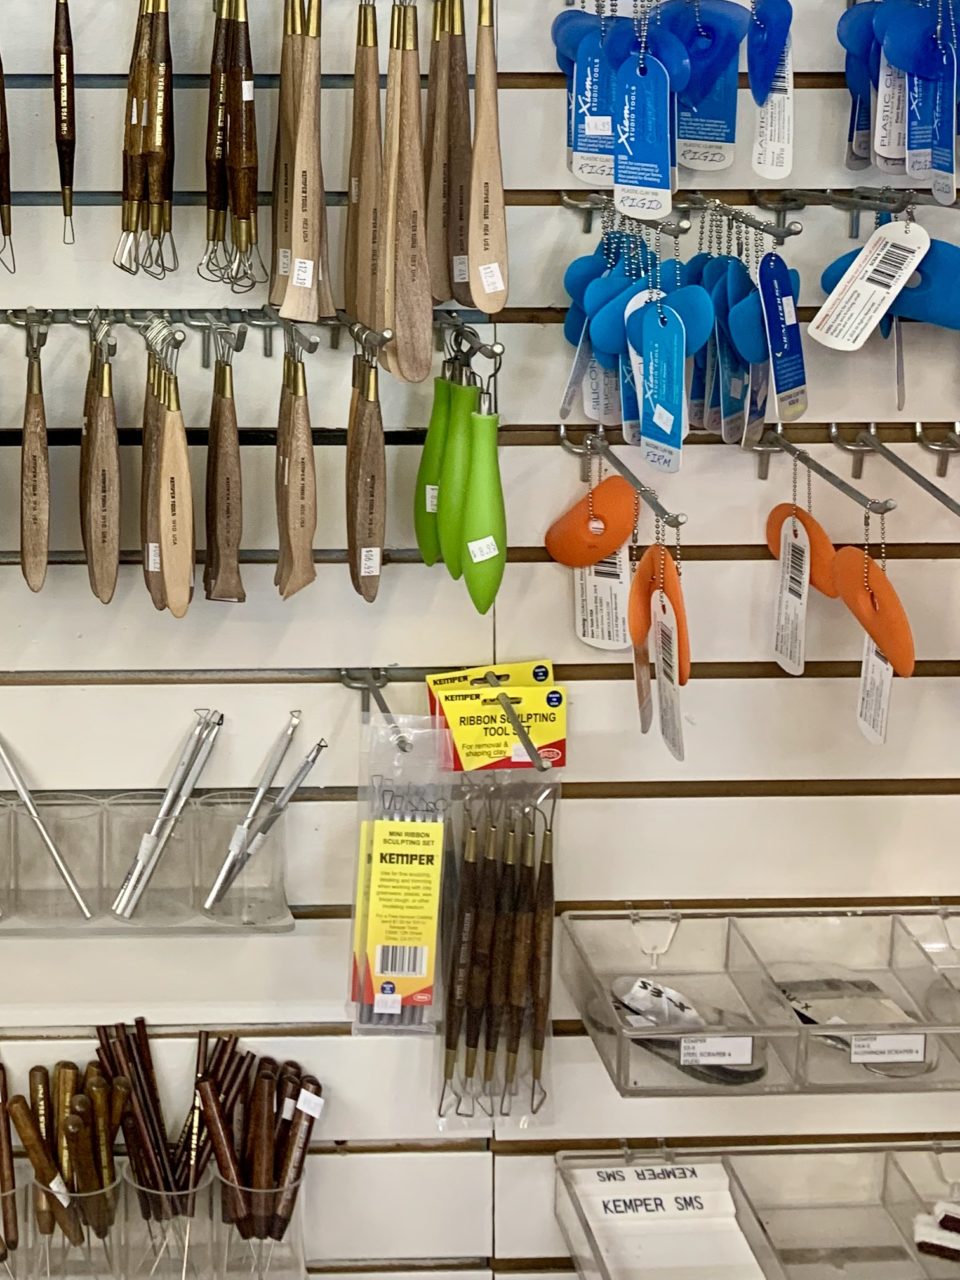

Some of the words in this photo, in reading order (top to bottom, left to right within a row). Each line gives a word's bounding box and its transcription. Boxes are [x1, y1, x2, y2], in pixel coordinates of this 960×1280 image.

[880, 94, 891, 147] PLASTIC
[681, 150, 726, 162] RIGID
[619, 197, 663, 210] RIGID
[646, 451, 672, 466] FIRM
[433, 675, 469, 686] KEMPER
[444, 693, 481, 702] KEMPER
[459, 715, 497, 726] RIBBON
[483, 727, 510, 737] TOOL
[513, 725, 532, 736] ST
[474, 742, 502, 750] removal
[465, 750, 491, 759] shaping
[493, 749, 507, 758] clay
[382, 838, 421, 846] SCULPTING
[379, 852, 436, 866] KEMPER
[597, 1169, 626, 1183] SMS
[635, 1167, 698, 1182] KEMPER
[602, 1197, 666, 1214] KEMPER
[674, 1196, 705, 1212] SMS
